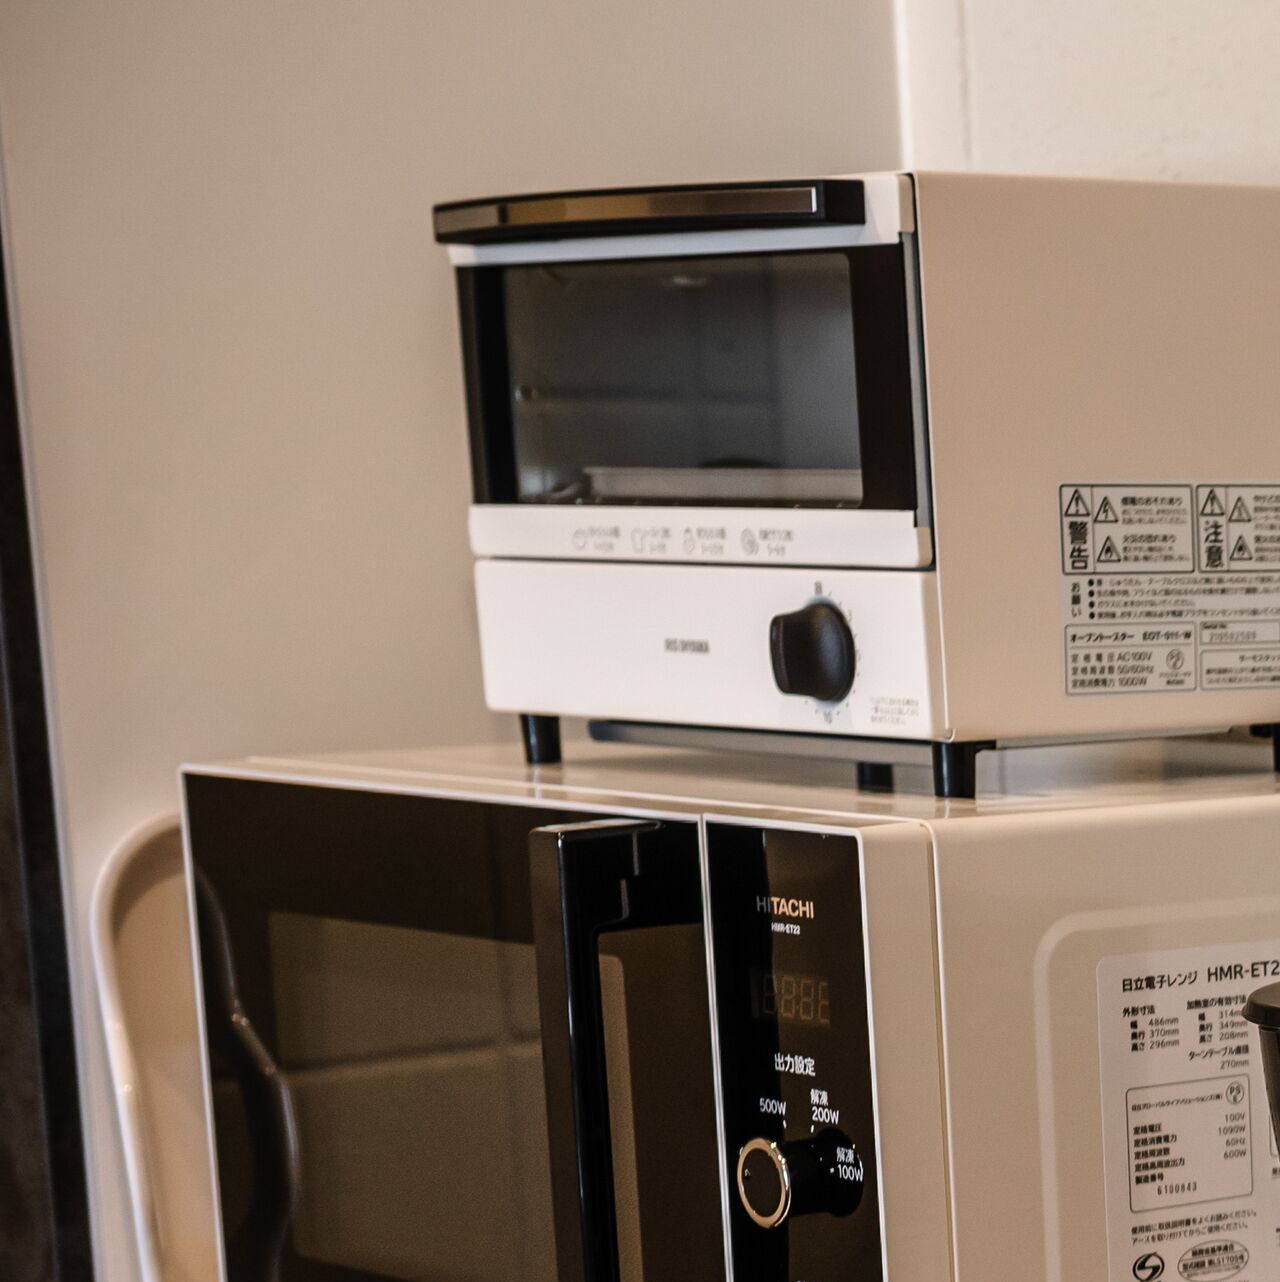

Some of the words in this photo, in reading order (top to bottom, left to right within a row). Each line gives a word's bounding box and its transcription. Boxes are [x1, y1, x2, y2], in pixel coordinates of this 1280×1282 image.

[1069, 521, 1089, 570] 警告
[1204, 520, 1224, 568] 注意
[756, 896, 814, 919] HITACHI
[1122, 970, 1198, 993] 日立電子レンジ
[1122, 1004, 1156, 1018] 外形寸法
[1148, 1017, 1179, 1027] 486mm
[1149, 1028, 1180, 1038] 370mm
[1149, 1039, 1180, 1050] 296mm
[774, 1052, 816, 1077] 出力設定
[1220, 1059, 1250, 1070] 270mm
[810, 1088, 829, 1106] 解凍
[759, 1098, 787, 1116] 500W
[811, 1106, 840, 1124] 200W
[1224, 1111, 1246, 1122] 100V
[1218, 1125, 1246, 1136] 1090W
[836, 1146, 854, 1164] 解凍
[1223, 1148, 1247, 1160] 600W
[837, 1163, 864, 1182] 100W
[1157, 1181, 1197, 1196] 6100843
